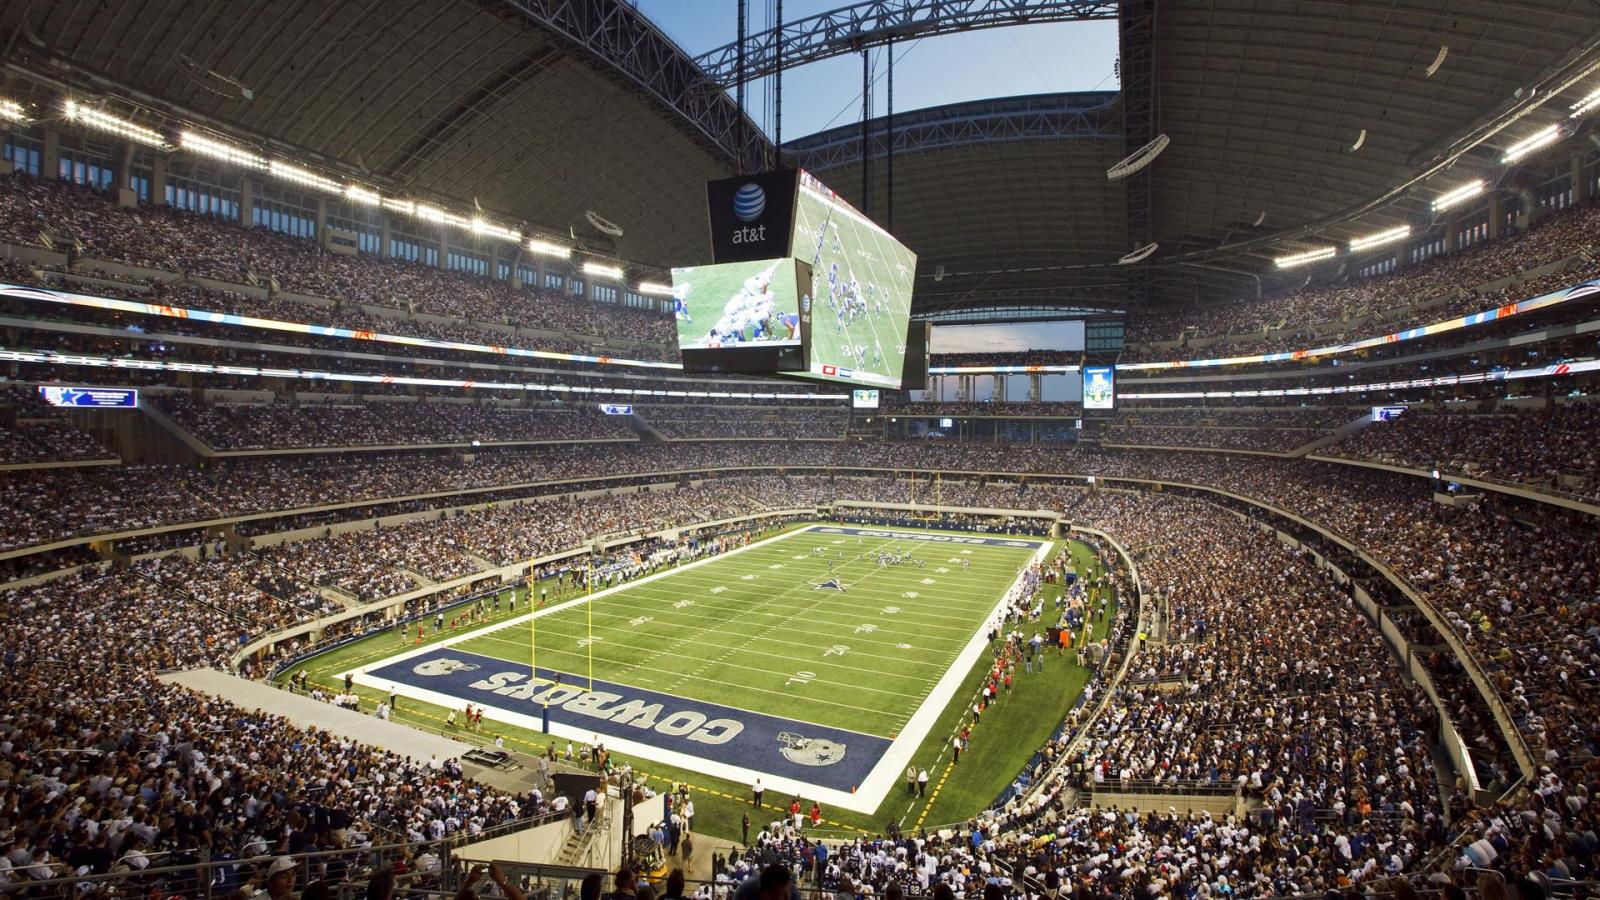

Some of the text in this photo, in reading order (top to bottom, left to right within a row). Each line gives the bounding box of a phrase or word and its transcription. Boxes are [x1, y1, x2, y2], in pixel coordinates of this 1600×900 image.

[733, 225, 766, 244] at&t
[789, 670, 817, 684] 10
[468, 672, 745, 745] COWBOYS
